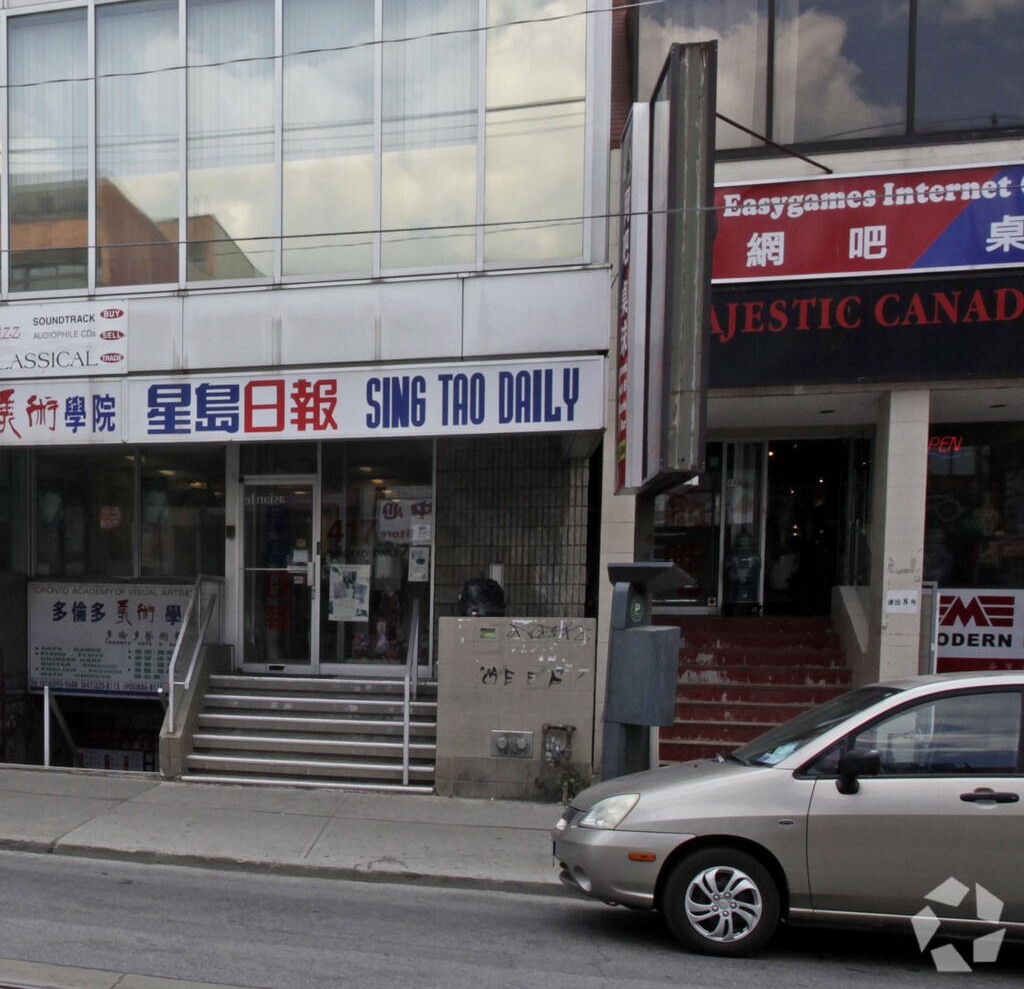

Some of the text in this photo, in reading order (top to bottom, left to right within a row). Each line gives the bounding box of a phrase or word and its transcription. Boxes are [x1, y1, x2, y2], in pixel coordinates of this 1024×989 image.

[723, 185, 876, 220] Easygames
[882, 175, 1012, 207] Internet
[746, 225, 888, 268] 網吧
[32, 313, 96, 327] SOUNDTRACK
[103, 309, 122, 319] BUY
[33, 329, 96, 341] AUDIOPHILE CDs
[102, 331, 122, 340] SELL
[102, 353, 123, 363] TRADE
[366, 367, 579, 429] SING TAO DAILY
[147, 378, 338, 435] 星島日報
[928, 436, 964, 453] PEN
[31, 586, 185, 597] TORONTO ACADEMY OF VISUAL ARTS
[52, 599, 182, 626] 多倫多美術學
[938, 632, 1013, 648] ODERN
